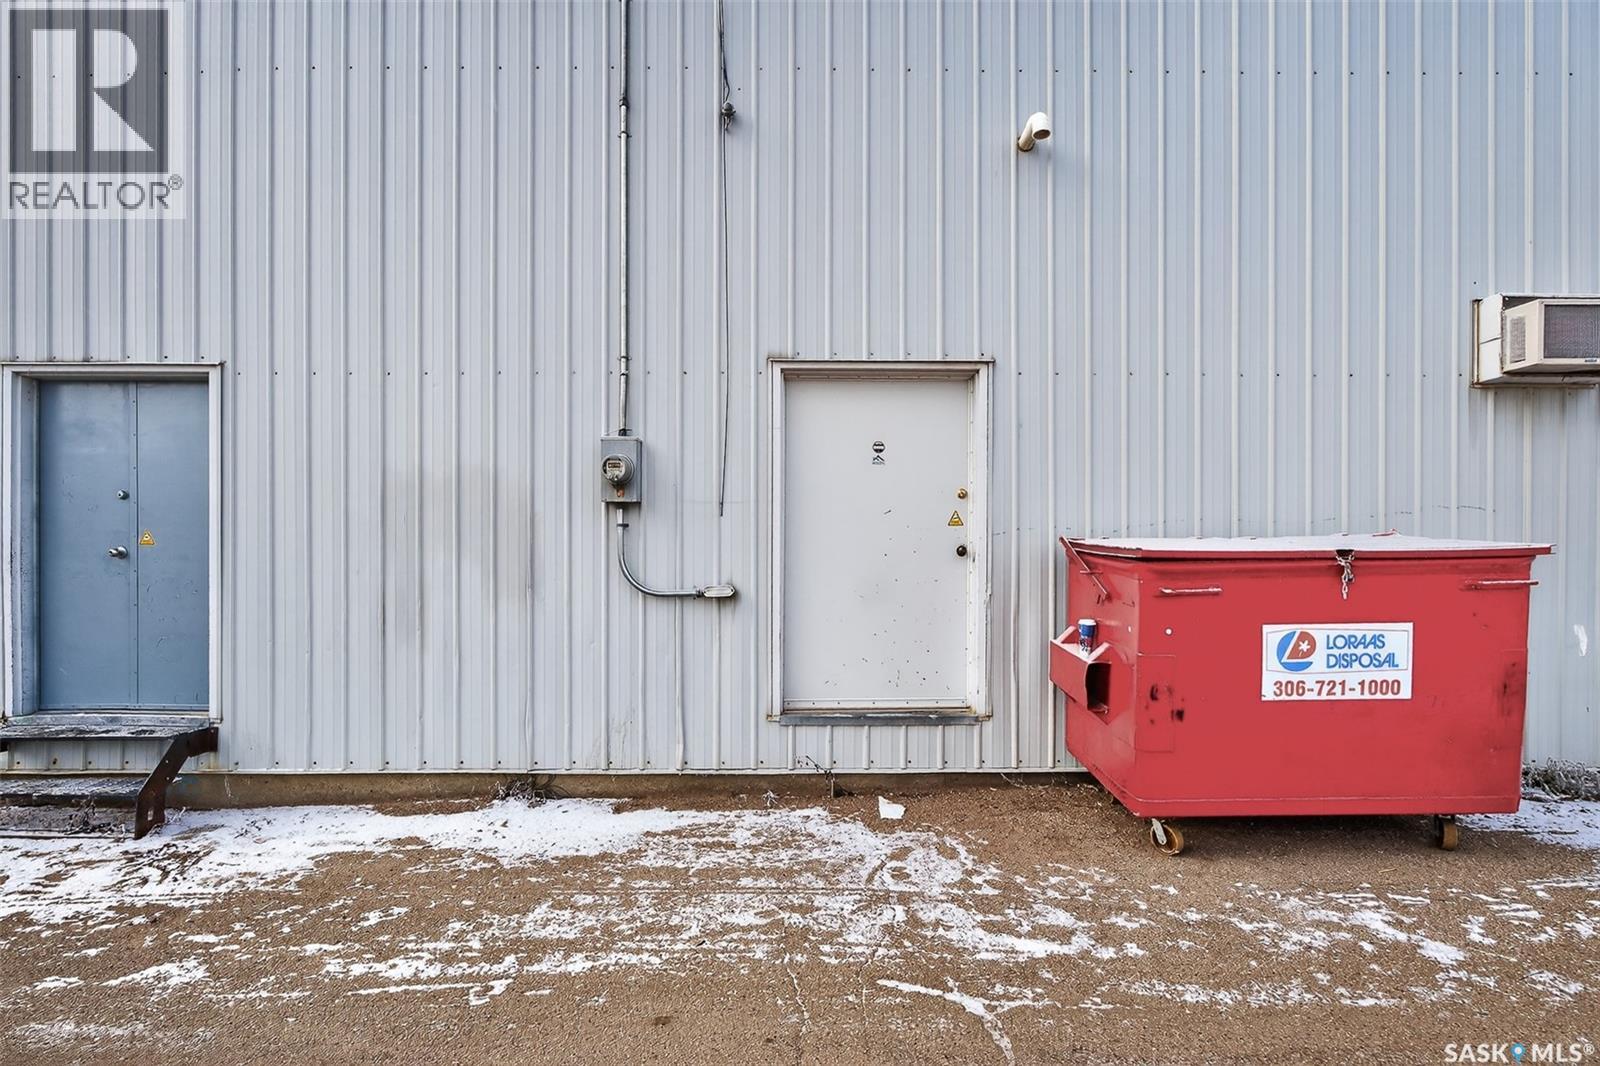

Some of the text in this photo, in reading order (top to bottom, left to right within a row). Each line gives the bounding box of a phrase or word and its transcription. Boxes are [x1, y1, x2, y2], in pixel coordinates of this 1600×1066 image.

[1326, 633, 1386, 650] LORAAS
[1326, 652, 1399, 669] DISPOSAL
[1273, 679, 1401, 697] 306-721-1000
